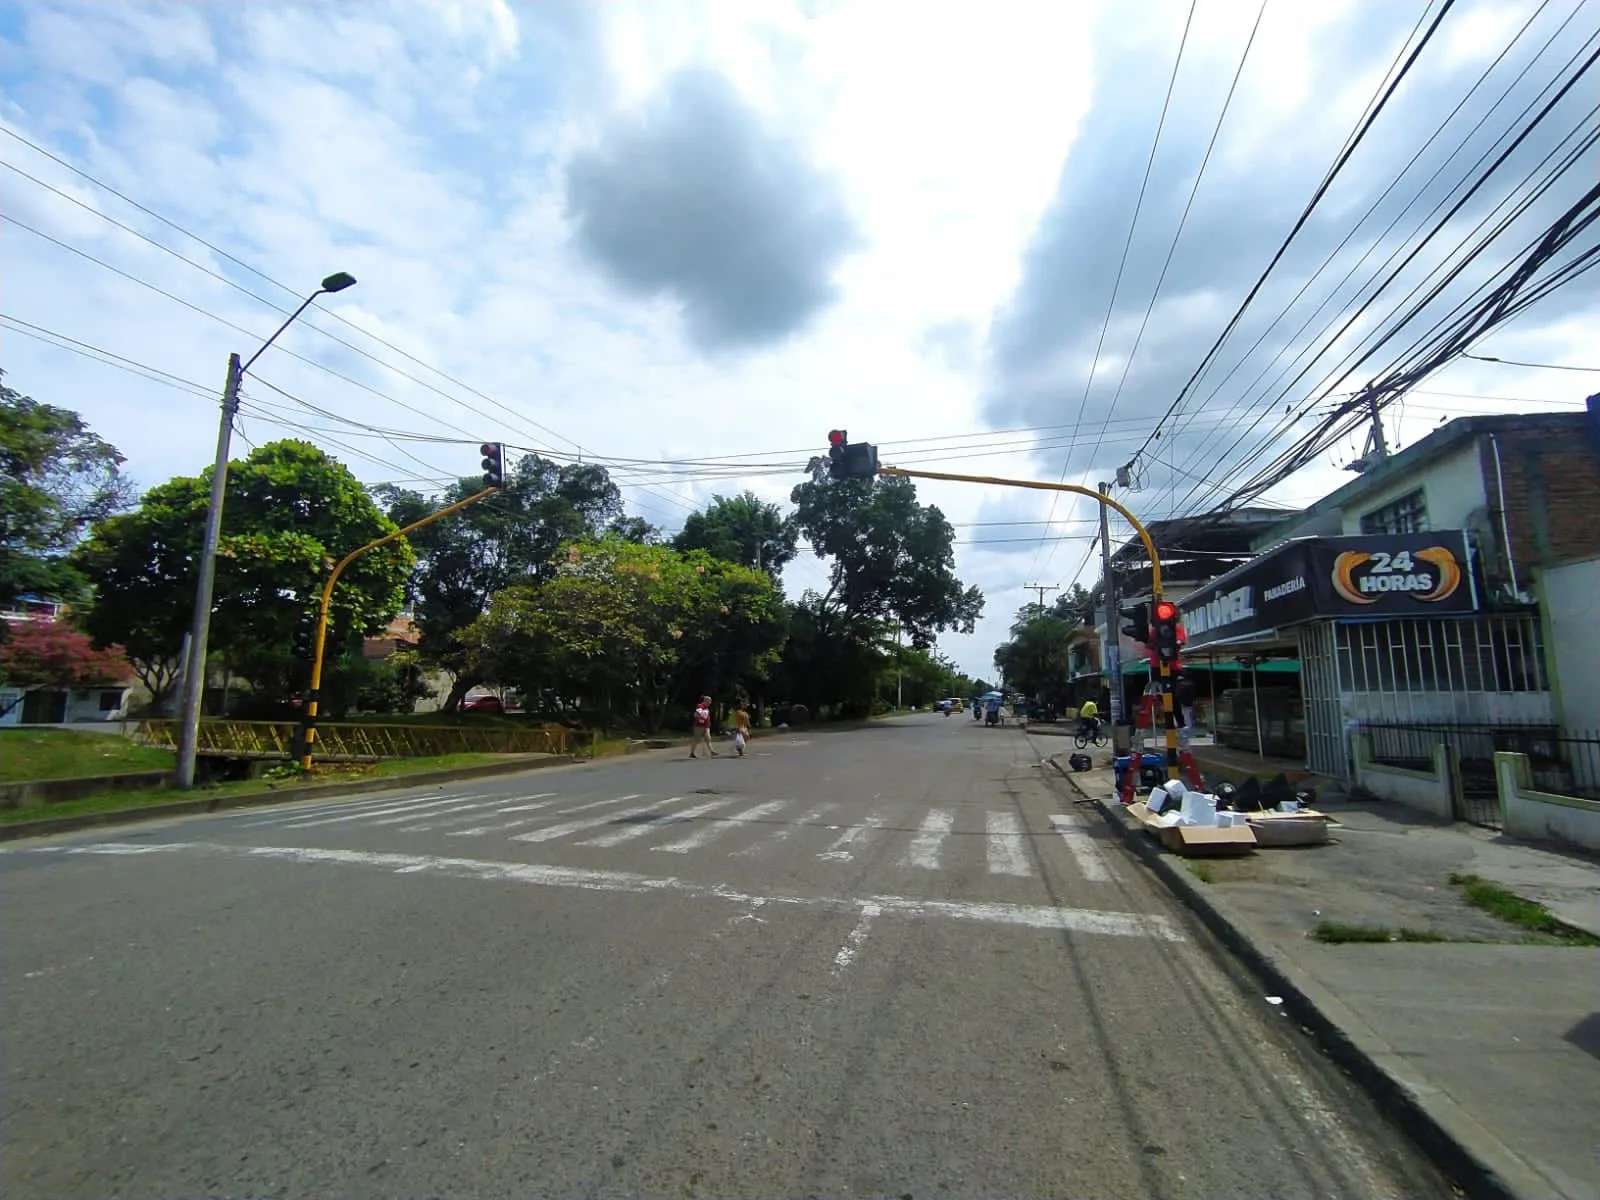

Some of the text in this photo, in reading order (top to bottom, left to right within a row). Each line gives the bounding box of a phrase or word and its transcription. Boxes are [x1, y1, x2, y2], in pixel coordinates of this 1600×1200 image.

[1370, 551, 1414, 573] 24
[1263, 576, 1305, 602] PANADERÍA
[1360, 573, 1432, 592] HORAS
[1206, 586, 1254, 629] LÓPEZ
